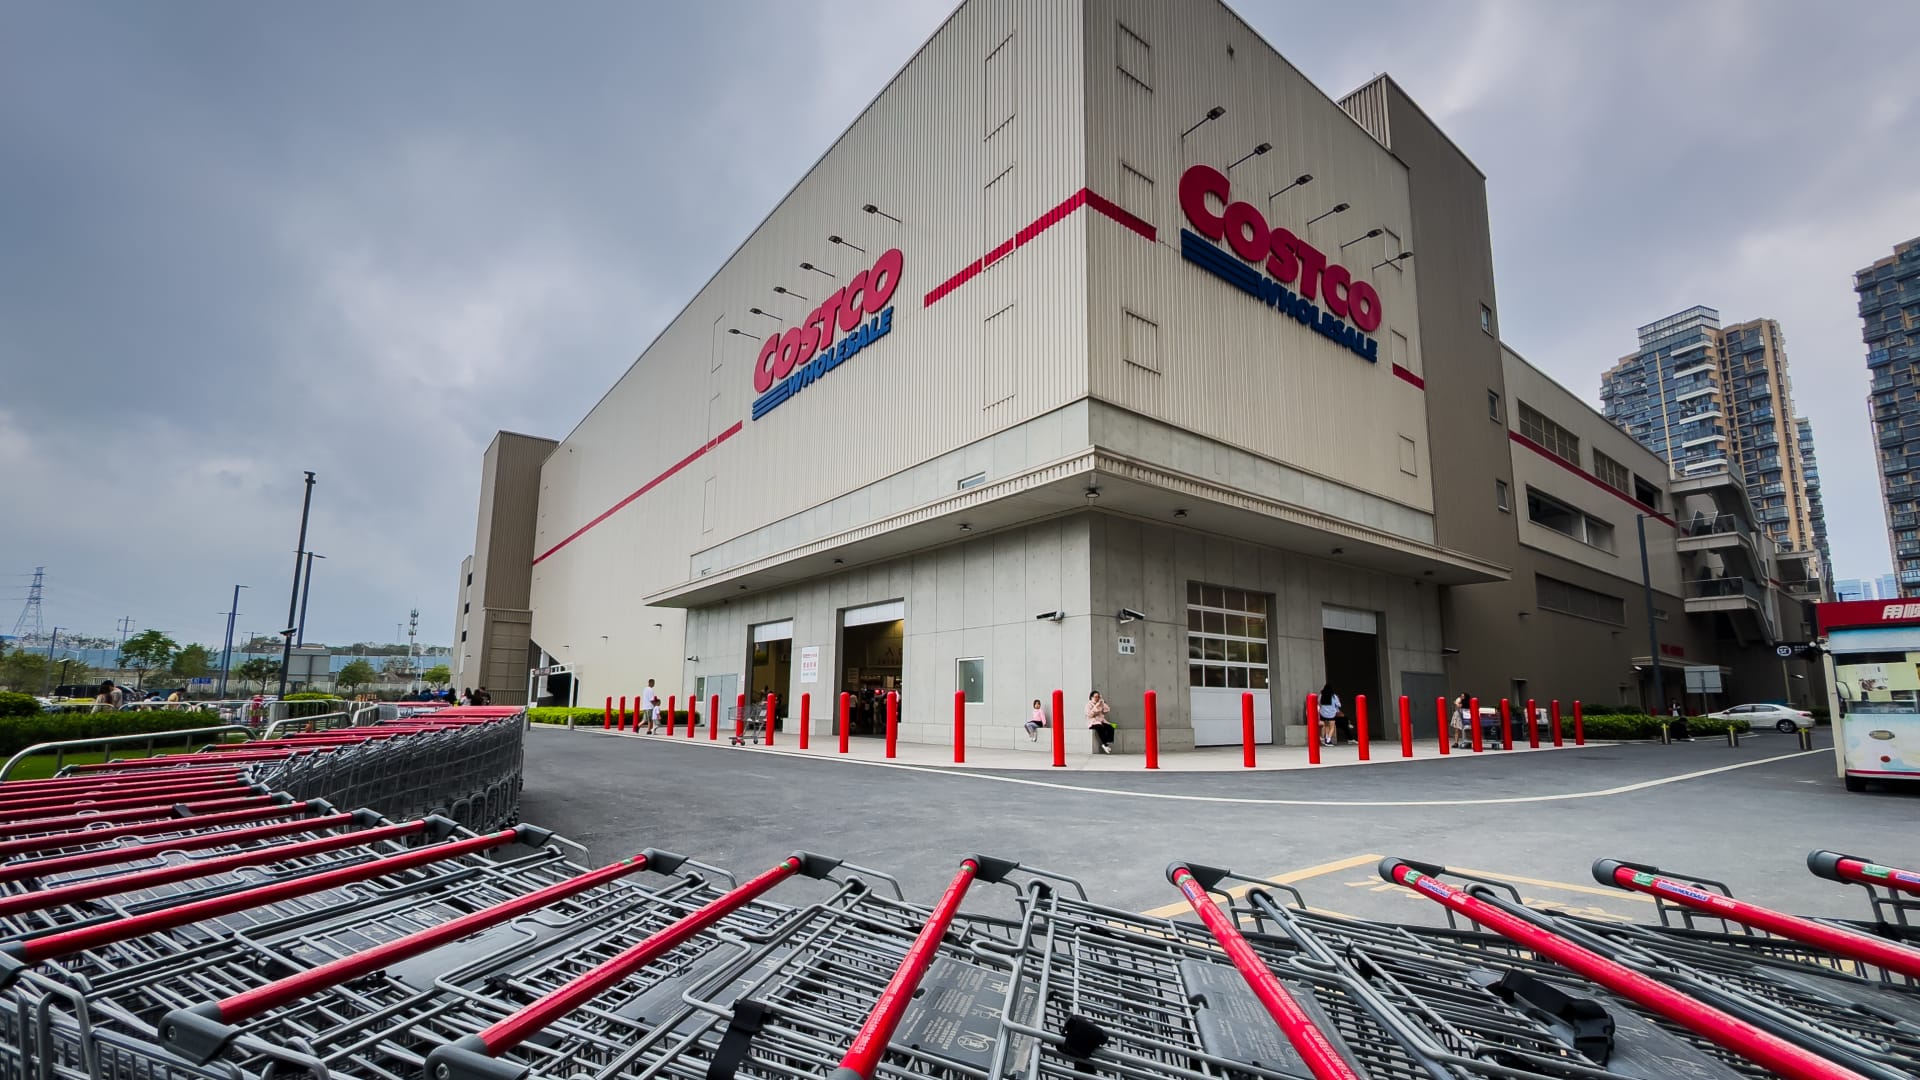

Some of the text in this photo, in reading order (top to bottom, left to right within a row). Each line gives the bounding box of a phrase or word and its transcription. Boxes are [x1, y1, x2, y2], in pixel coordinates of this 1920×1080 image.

[1179, 165, 1382, 332] COSTCO
[754, 248, 903, 393] COSTCO
[787, 306, 894, 396] WHOLESALE
[1255, 271, 1377, 363] WHOLESALE
